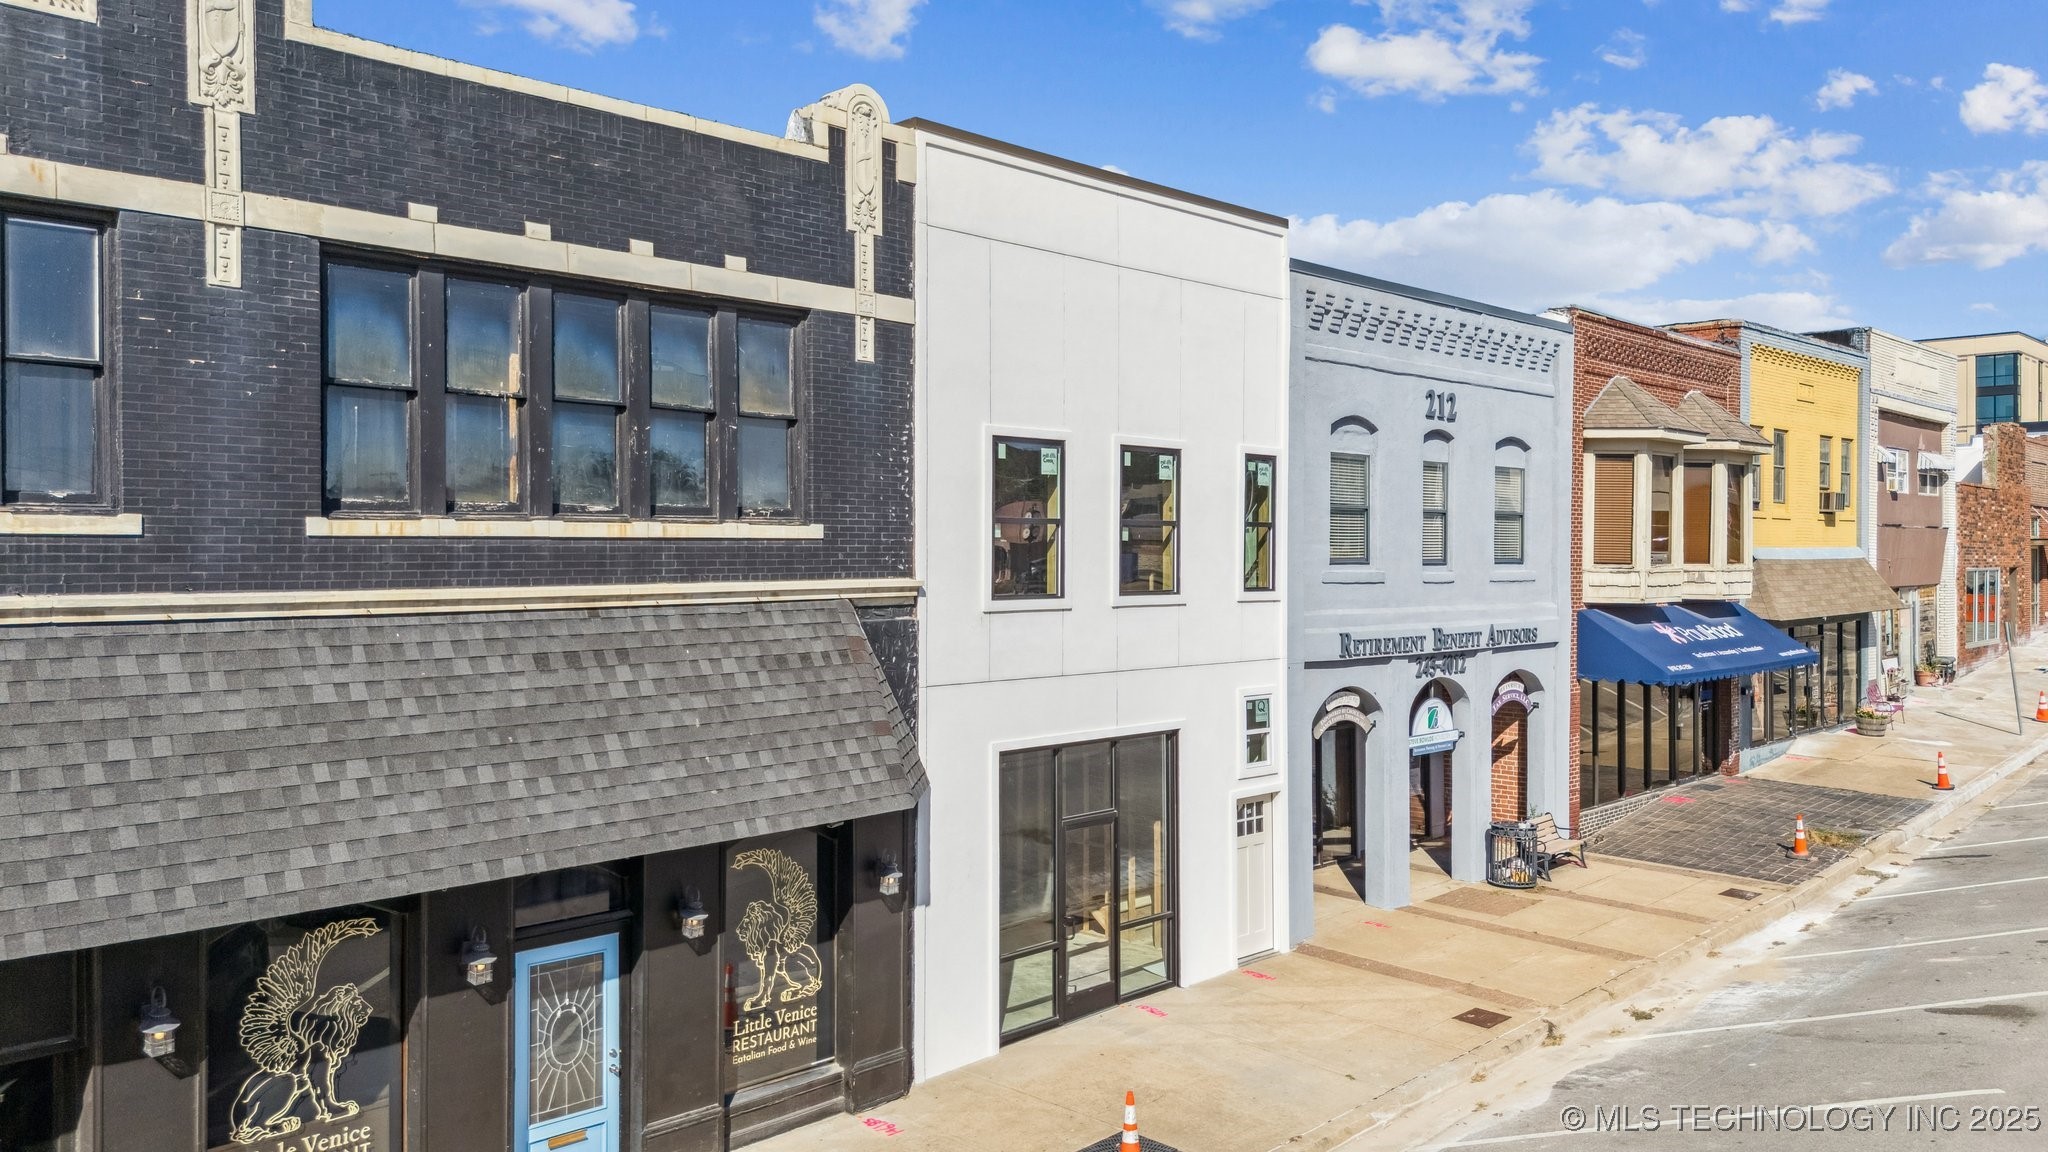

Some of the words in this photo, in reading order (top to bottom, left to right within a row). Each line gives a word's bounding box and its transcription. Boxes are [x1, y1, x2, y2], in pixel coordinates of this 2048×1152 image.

[1425, 389, 1457, 423] 212
[1339, 632, 1426, 659] RETIREMENT
[1432, 627, 1482, 651] BENEFIT
[1487, 624, 1538, 648] ADVISORS
[1415, 653, 1467, 679] 245-4012
[732, 1019, 818, 1053] RESTAURANT
[733, 1013, 772, 1037] Little
[774, 1004, 818, 1026] Venice
[732, 1050, 766, 1065] Eatalian
[768, 1042, 787, 1055] Food
[789, 1042, 796, 1050] &
[797, 1035, 817, 1047] Wine
[301, 1125, 372, 1152] Venice
